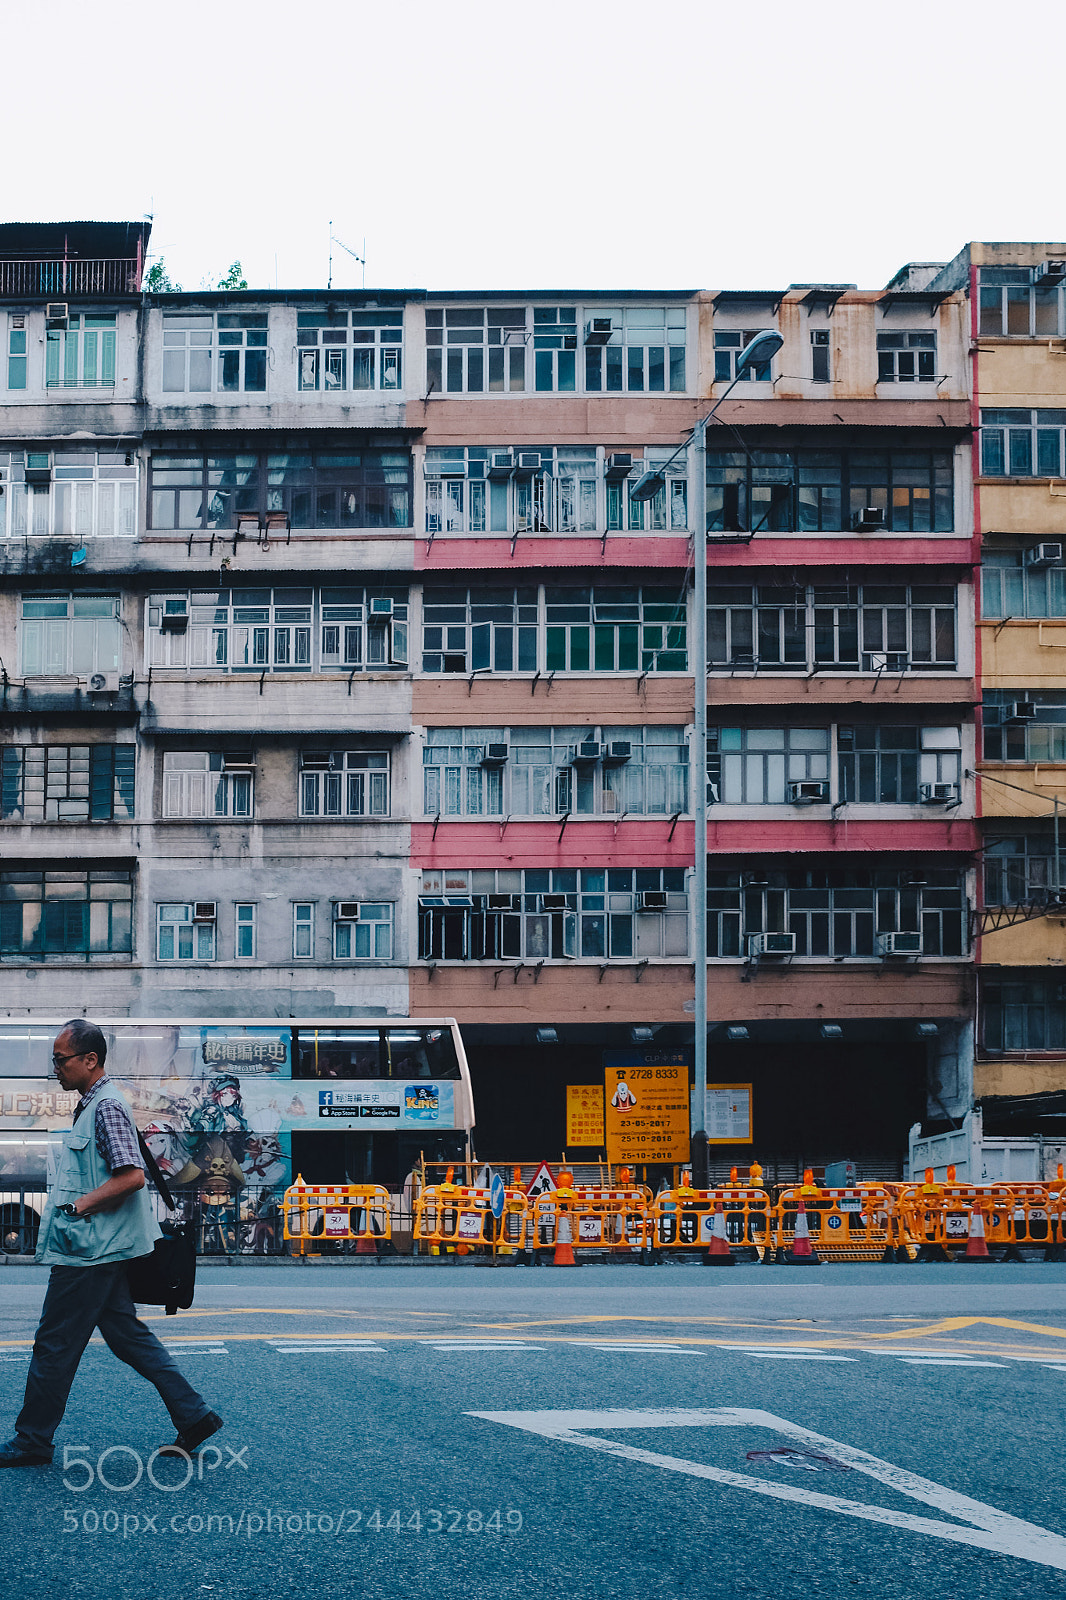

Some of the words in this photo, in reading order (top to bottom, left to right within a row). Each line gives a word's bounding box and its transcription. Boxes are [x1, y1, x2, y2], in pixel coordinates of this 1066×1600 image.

[205, 1042, 285, 1061] 秘海編年史
[630, 1069, 653, 1079] 2728
[655, 1069, 679, 1079] 8333
[0, 1091, 82, 1117] 上決戰
